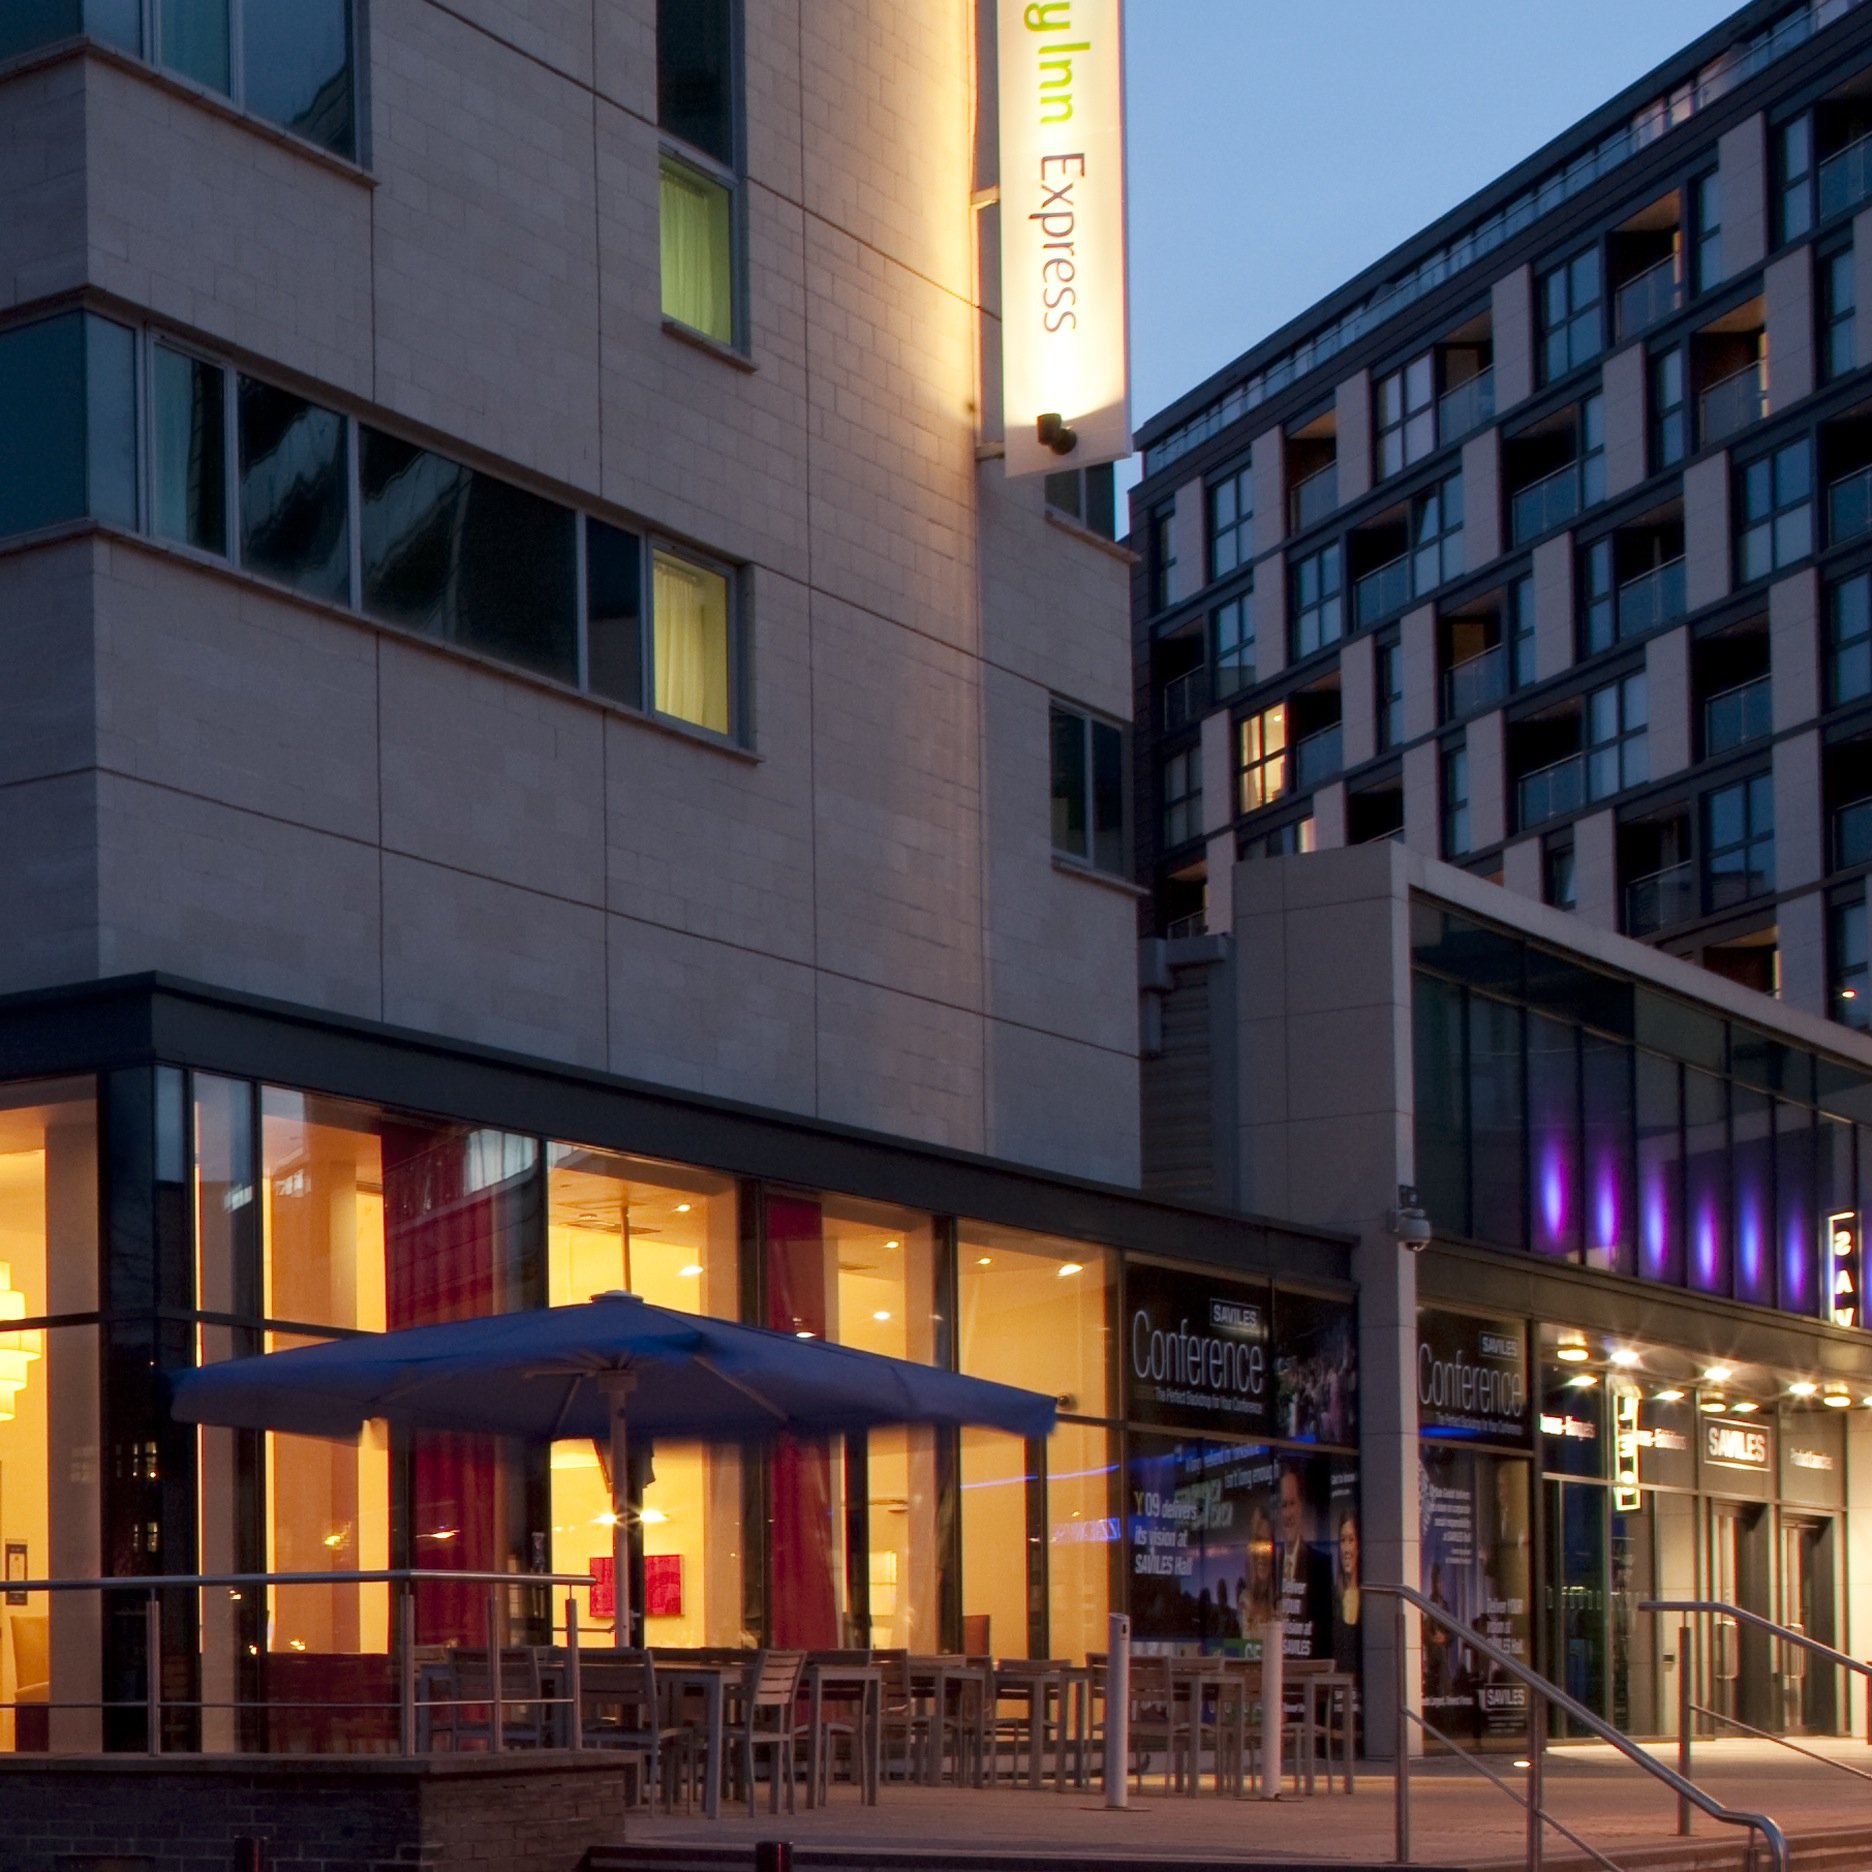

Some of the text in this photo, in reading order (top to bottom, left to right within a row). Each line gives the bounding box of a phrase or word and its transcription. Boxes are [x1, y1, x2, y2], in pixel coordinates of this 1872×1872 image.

[1038, 41, 1091, 124] Inn
[1028, 153, 1085, 333] Express
[1213, 1304, 1257, 1326] SAVILES
[1133, 1310, 1263, 1394] Conference
[1481, 1336, 1517, 1357] SAVILES
[1418, 1343, 1521, 1417] Conference
[1708, 1427, 1766, 1462] SAVILES
[1135, 1554, 1173, 1576] SAVILES
[1487, 1689, 1524, 1706] SAVILES
